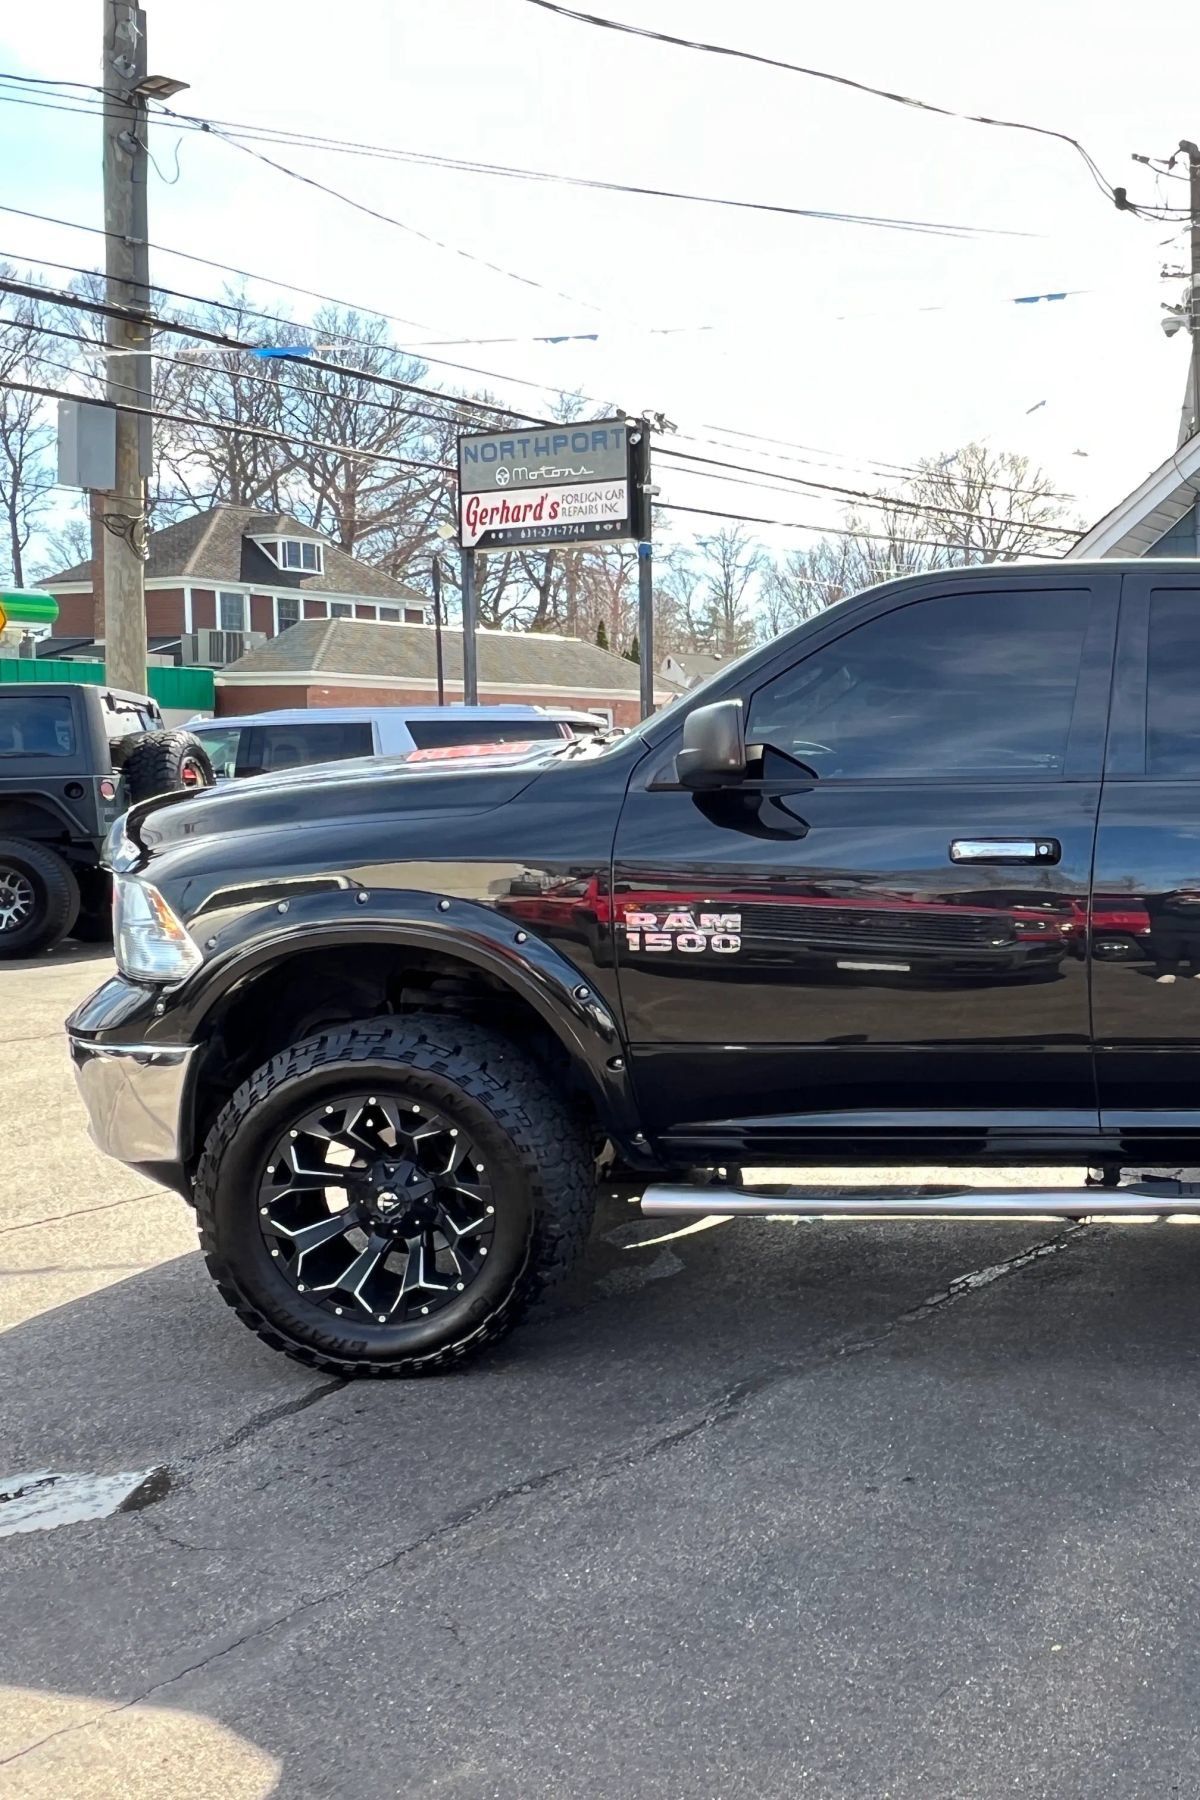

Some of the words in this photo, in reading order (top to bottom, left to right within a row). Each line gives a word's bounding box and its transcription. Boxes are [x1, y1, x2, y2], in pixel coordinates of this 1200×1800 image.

[464, 428, 625, 465] NORTHPORT
[512, 465, 595, 481] Motors
[561, 491, 603, 504] FOREIGN
[605, 488, 625, 501] CAR
[466, 493, 560, 537] Gerhard's
[561, 503, 599, 517] REPAIRS
[601, 502, 619, 515] INC
[520, 524, 585, 539] 631-271-7744
[625, 911, 742, 933] RAM
[625, 932, 742, 953] 1500
